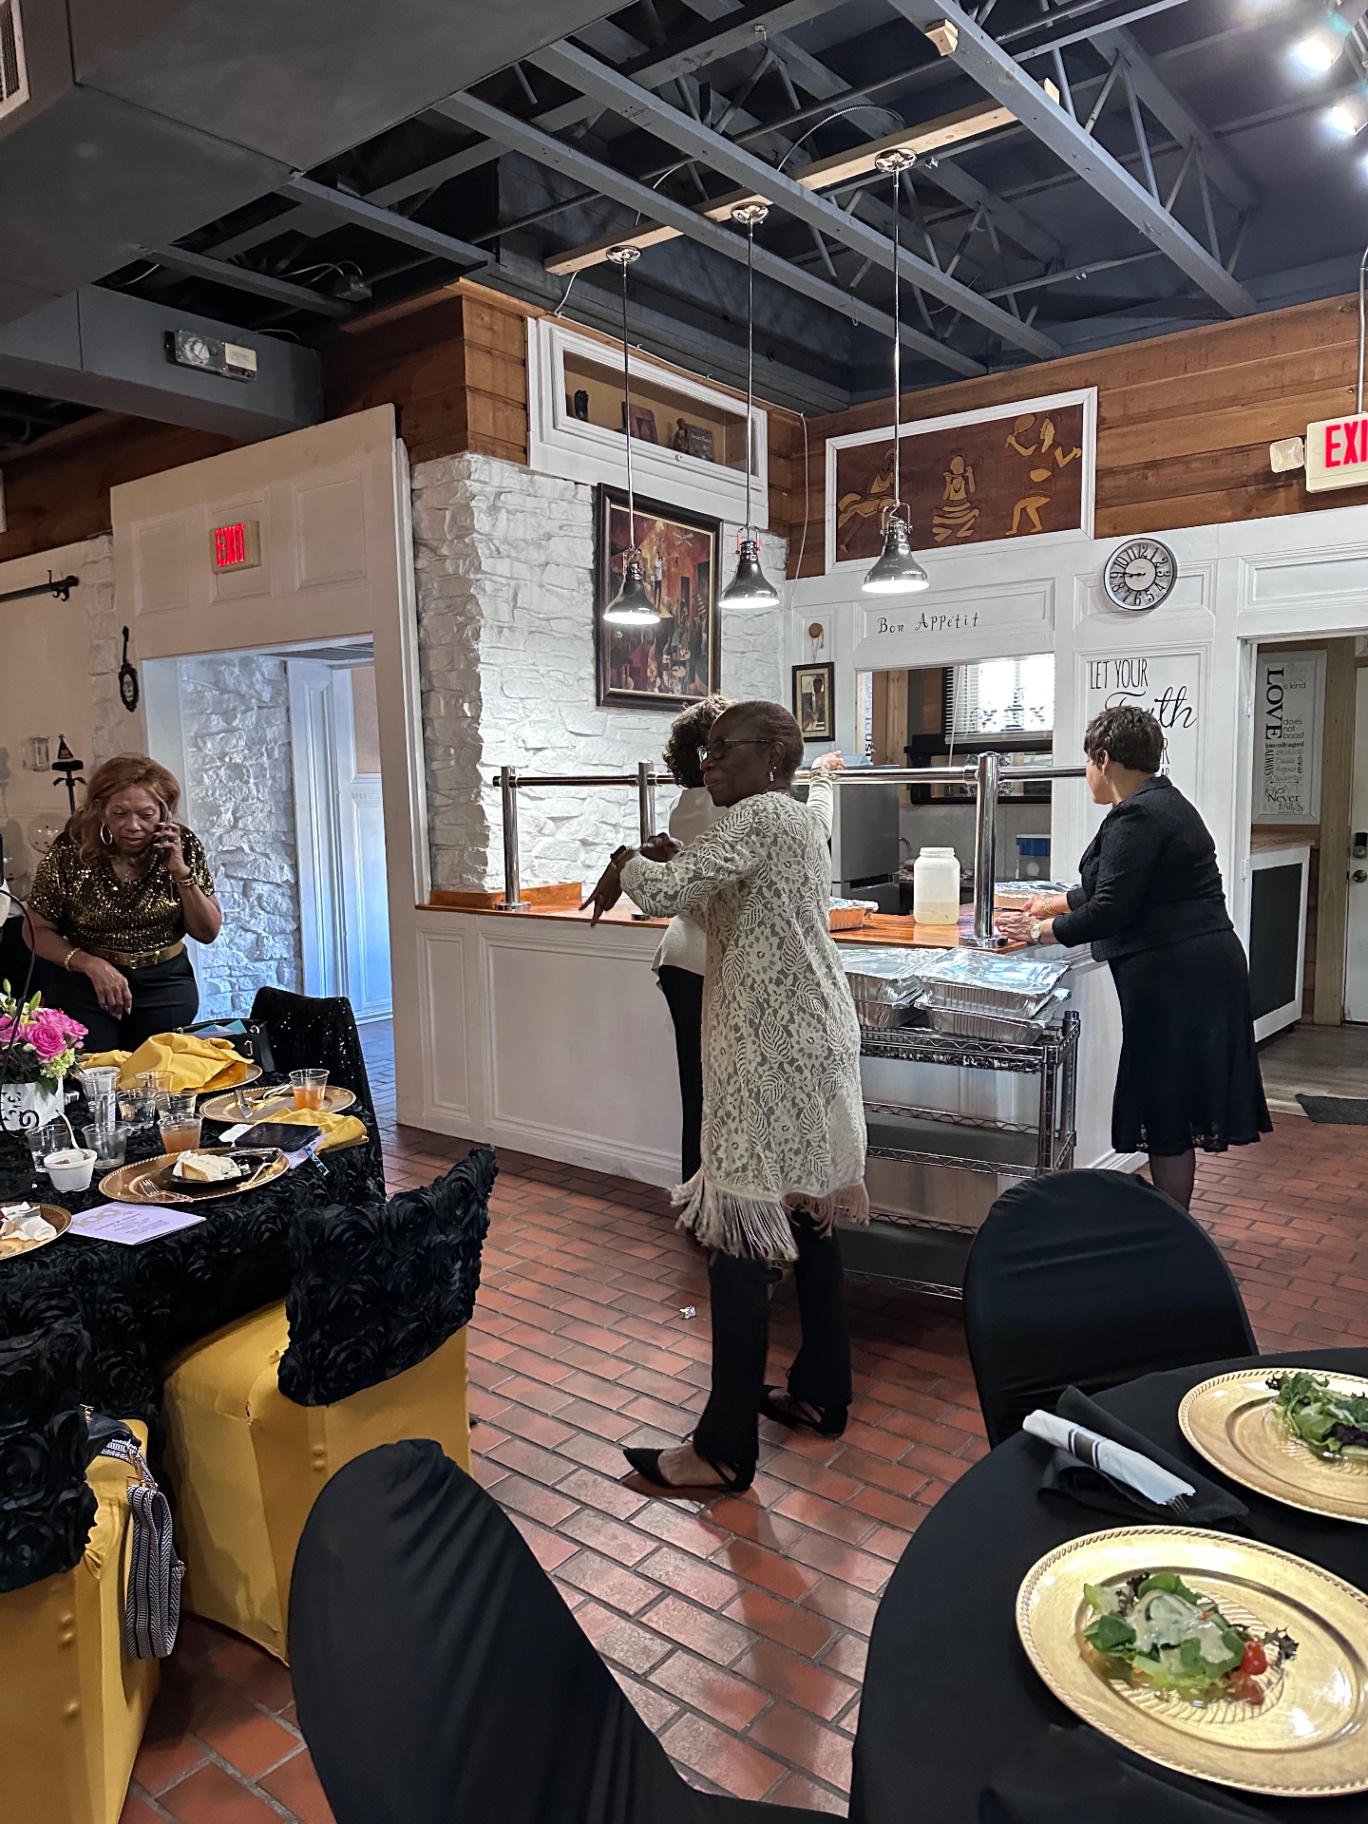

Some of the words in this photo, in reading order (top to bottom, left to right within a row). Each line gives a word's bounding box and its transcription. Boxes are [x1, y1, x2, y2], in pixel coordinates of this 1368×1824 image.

[1325, 419, 1368, 468] EXI
[217, 524, 244, 566] EXIT
[1138, 542, 1148, 558] 12
[1124, 546, 1137, 561] 11
[1150, 547, 1159, 561] 1
[1114, 556, 1128, 569] 10
[1154, 557, 1169, 568] 2
[1112, 582, 1126, 592] 8
[1153, 581, 1166, 591] 4
[1123, 588, 1132, 602] 7
[1135, 592, 1141, 606] 6
[1145, 588, 1154, 602] 5
[877, 616, 905, 635] Bon
[1090, 660, 1110, 690] LET
[1115, 658, 1149, 689] YOUR
[1289, 682, 1307, 690] kind
[1265, 667, 1285, 739] LOVE
[1267, 793, 1301, 803] Never
